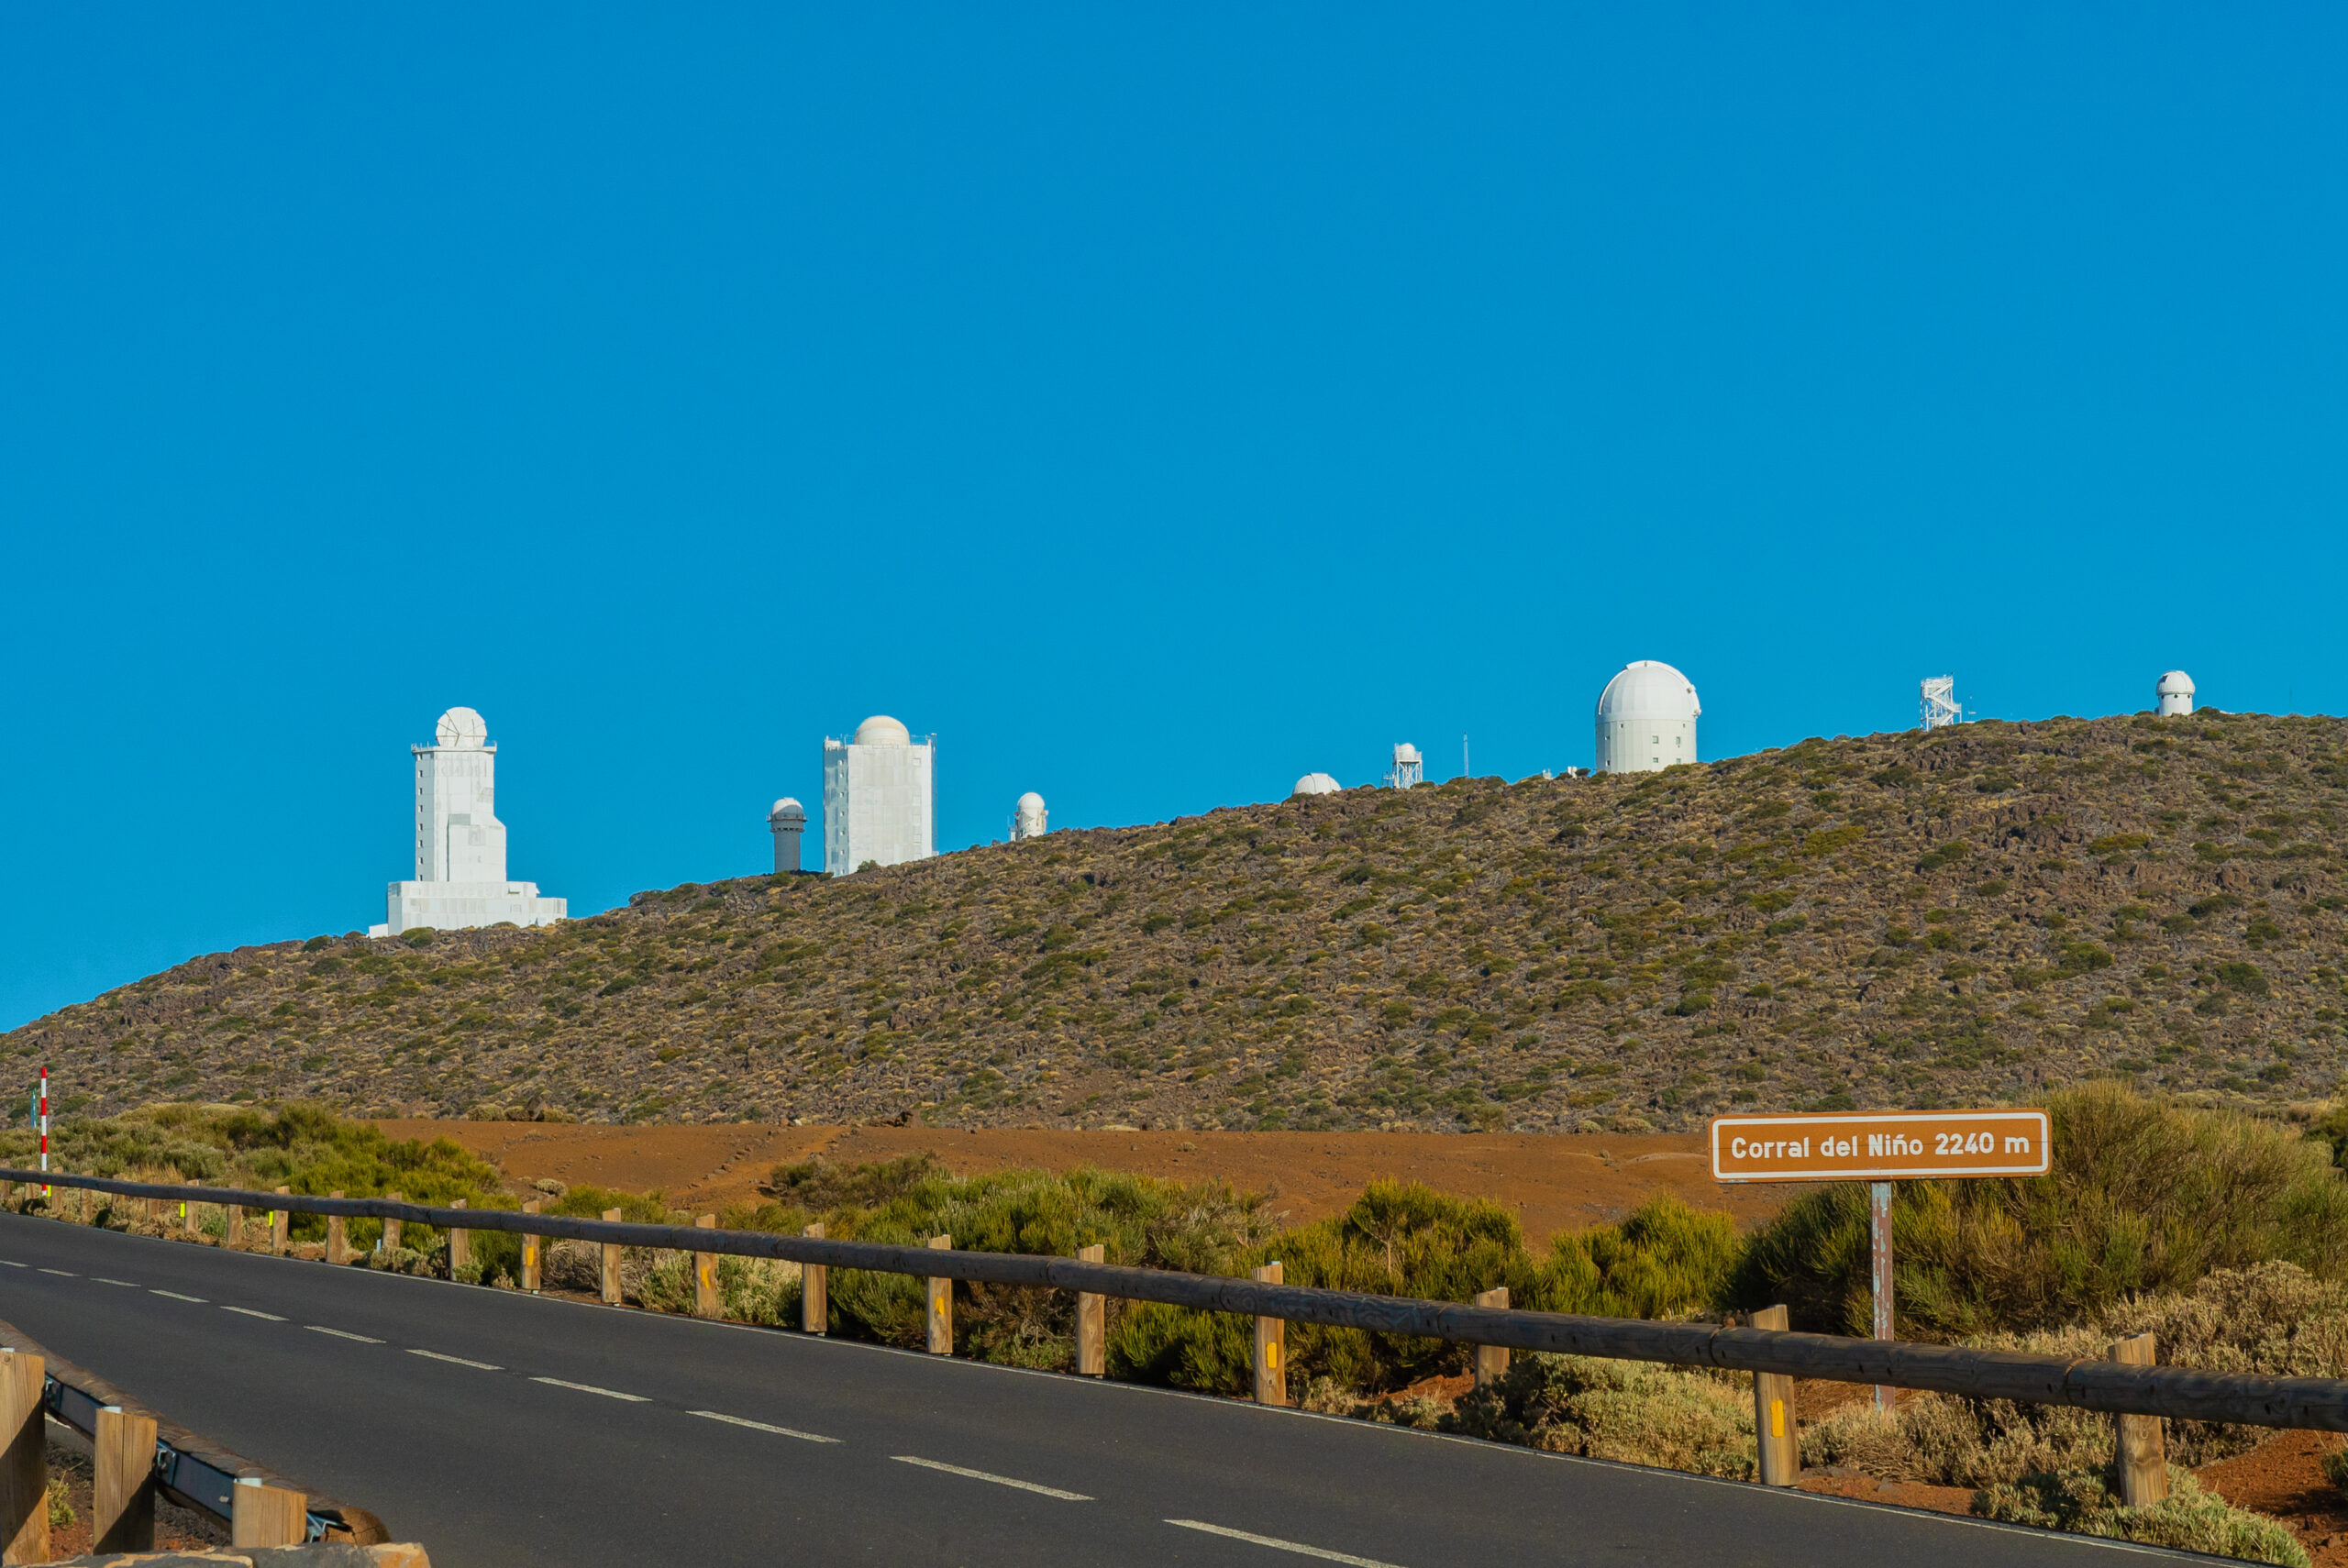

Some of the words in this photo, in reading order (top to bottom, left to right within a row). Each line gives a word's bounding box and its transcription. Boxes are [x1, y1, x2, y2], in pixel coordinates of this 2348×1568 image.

[1731, 1136, 1811, 1160] Corral
[1820, 1135, 1859, 1158] del
[1867, 1132, 1924, 1157] Niño
[1933, 1131, 1995, 1156] 2240
[2003, 1135, 2031, 1154] m
